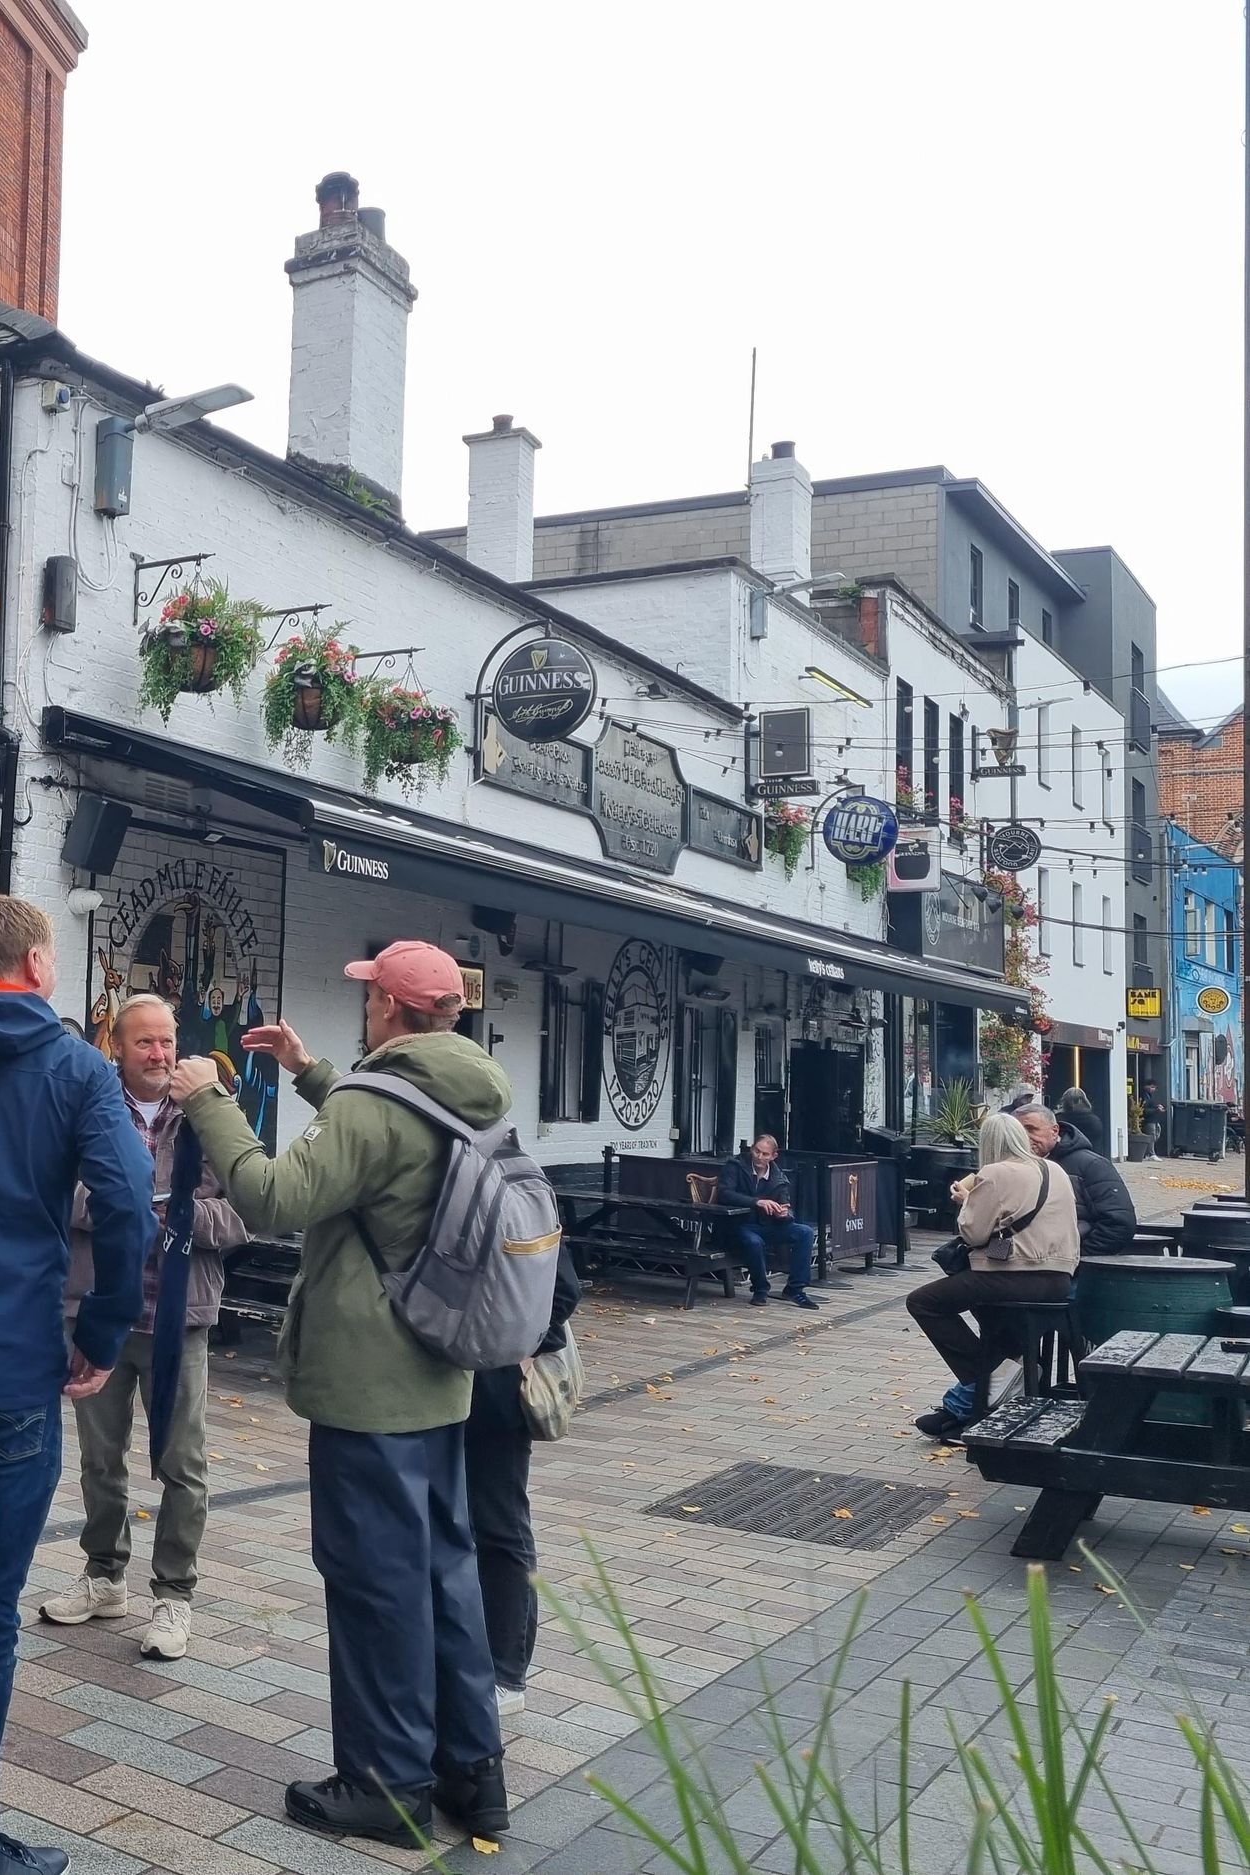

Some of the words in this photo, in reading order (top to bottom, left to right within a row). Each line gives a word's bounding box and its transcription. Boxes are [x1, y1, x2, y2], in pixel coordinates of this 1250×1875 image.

[499, 671, 583, 696] GUINNESS
[757, 783, 813, 796] GUINNESS
[833, 811, 883, 845] HARP
[337, 850, 389, 879] GUINNESS
[463, 973, 481, 1007] ly's
